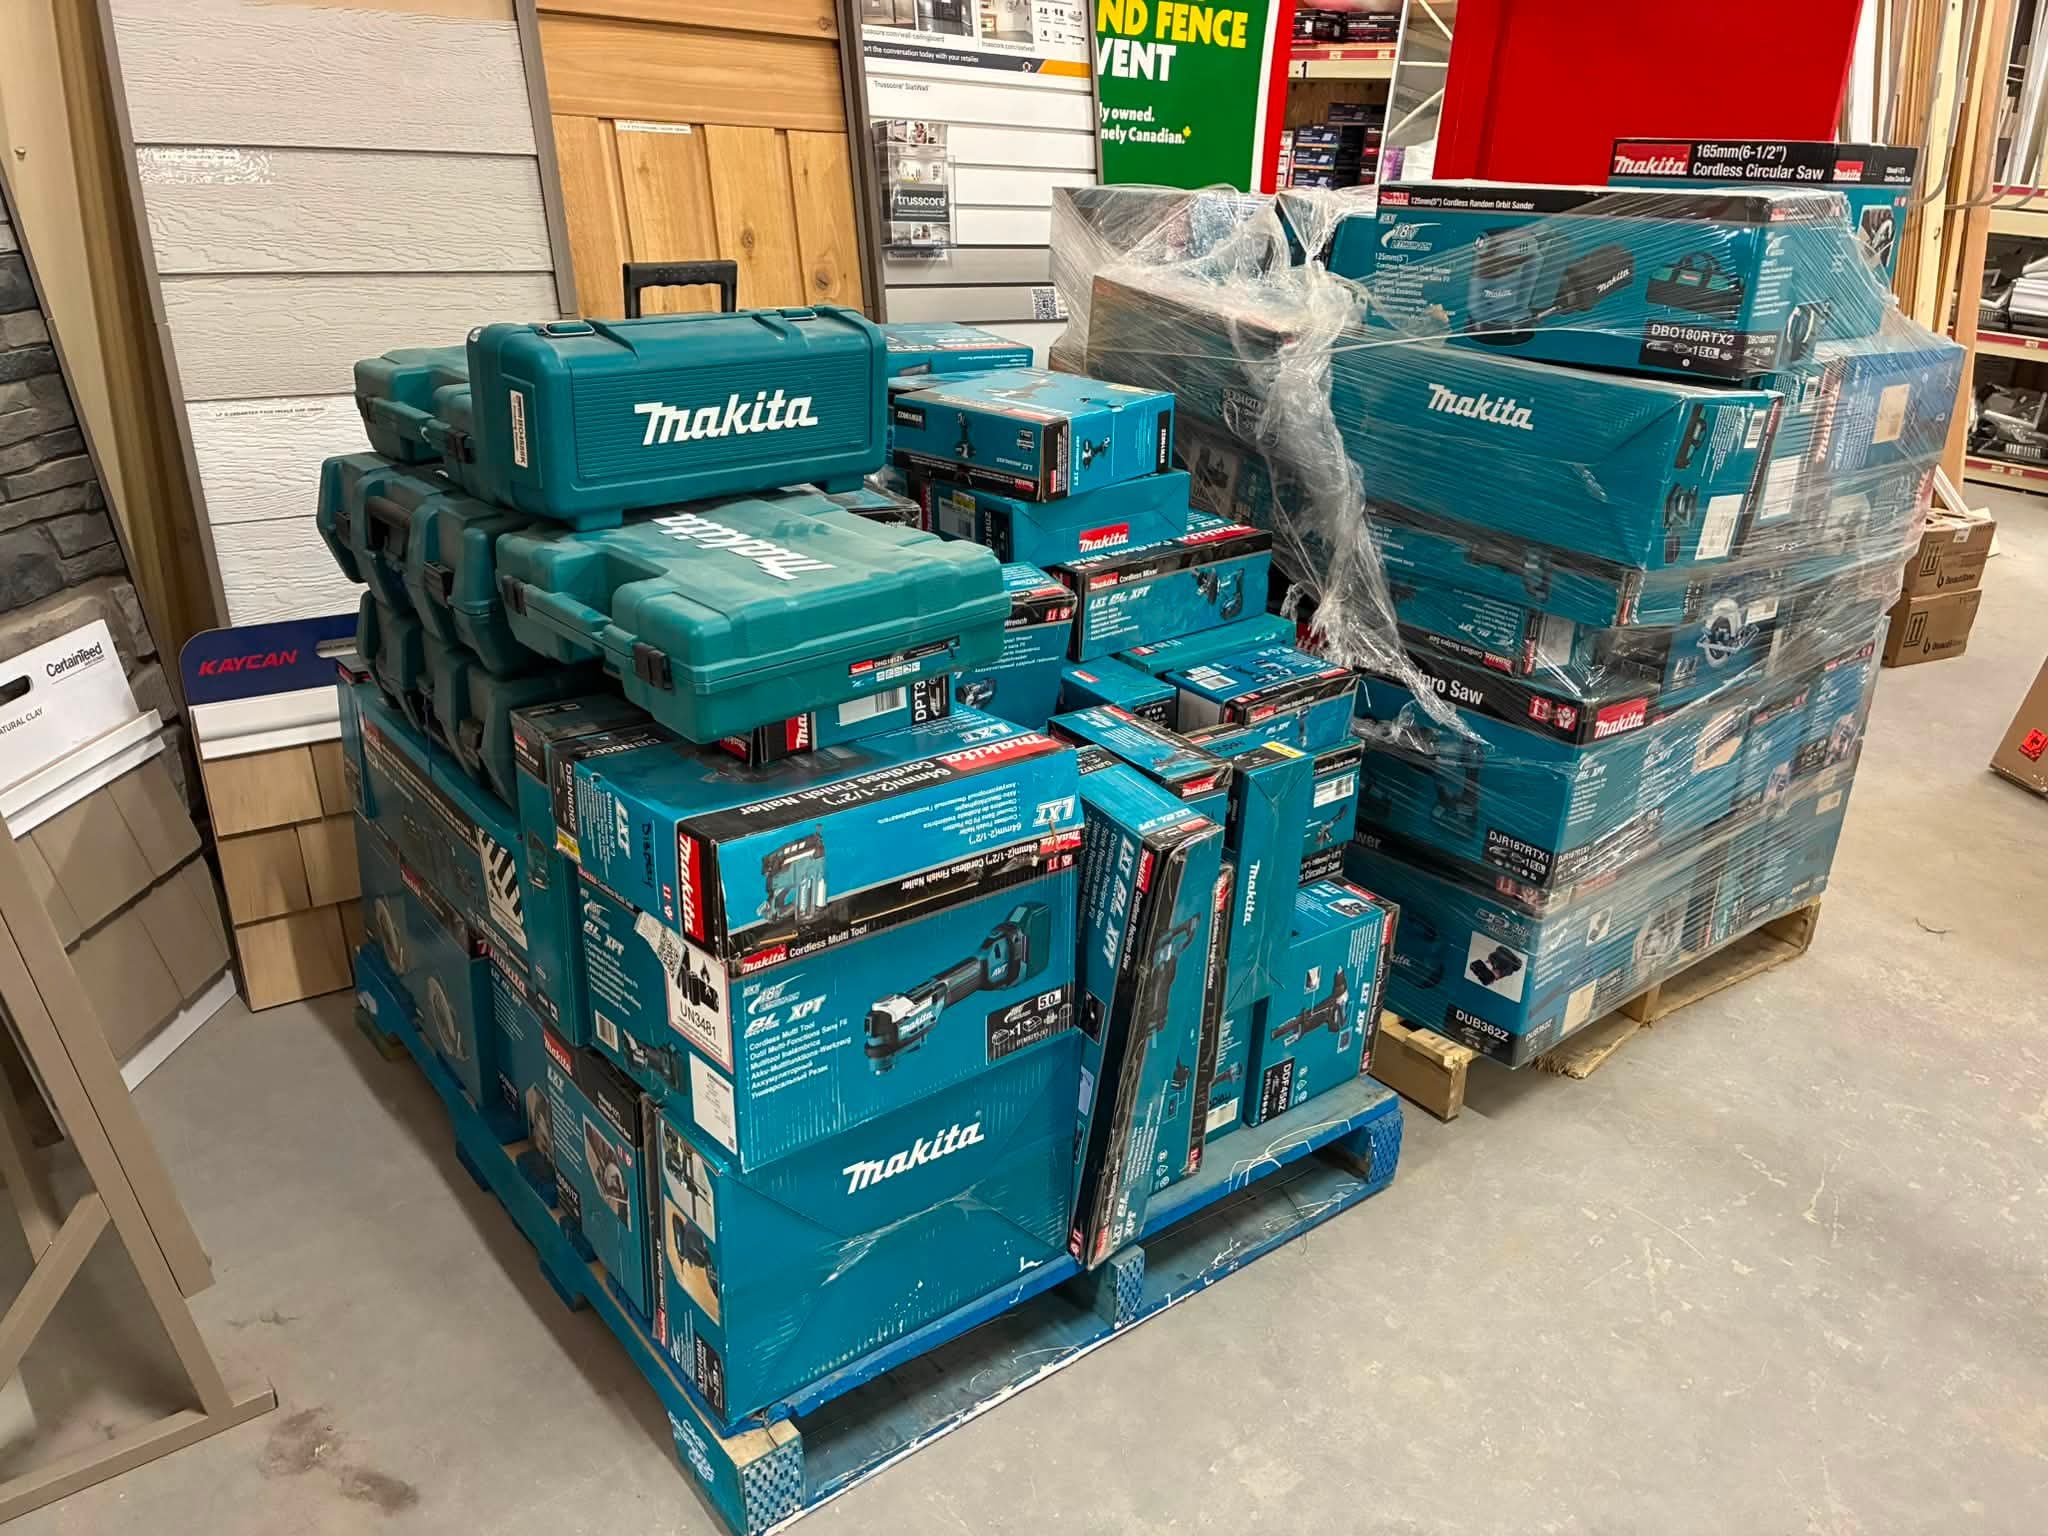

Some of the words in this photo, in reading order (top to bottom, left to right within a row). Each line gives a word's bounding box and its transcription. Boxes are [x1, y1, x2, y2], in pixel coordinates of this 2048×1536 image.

[1155, 1, 1248, 48] FENCE
[873, 46, 883, 54] the
[883, 47, 919, 57] conversation
[919, 51, 934, 60] today
[935, 52, 948, 61] with
[1095, 37, 1176, 81] VENT
[1111, 106, 1155, 122] owned.
[1128, 127, 1185, 144] Canadian.
[1697, 144, 1787, 161] 165mm(6-1/2")
[1692, 162, 1743, 177] Cordless
[1746, 164, 1794, 179] Circular
[1796, 166, 1824, 180] Saw
[897, 193, 946, 207] trusscore
[1443, 197, 1469, 207] Cordless
[1469, 199, 1495, 208] Random
[1496, 200, 1511, 209] Orbit
[1512, 200, 1535, 210] Sander
[1651, 324, 1735, 346] DBO180RTX2
[1119, 572, 1142, 583] Cordless
[1129, 585, 1151, 600] XPT
[46, 641, 103, 678] CertainTeed
[199, 650, 297, 676] KAYCAN
[1450, 679, 1483, 705] Saw
[0, 717, 25, 737] ATURAL
[25, 707, 43, 723] CLAY
[959, 720, 1012, 744] LXT
[861, 760, 936, 786] Cordless
[565, 763, 577, 832] DBN600Z
[800, 781, 859, 806] Finish
[823, 768, 951, 806] 64mm(2-1/2")
[740, 791, 801, 816] Nailer
[1032, 793, 1077, 827] LXT
[615, 796, 631, 860] LXT
[969, 822, 1022, 845] 64mm(2-1/2")
[985, 842, 1038, 866] 64mm(2-1/2")
[1105, 832, 1118, 873] Cordless
[1118, 833, 1135, 880] LXT
[1489, 831, 1550, 863] DJR187RTX1
[926, 867, 950, 883] Finish
[951, 857, 984, 875] Cordless
[901, 876, 925, 891] Nailer
[1131, 890, 1143, 924] Cordless
[604, 934, 625, 956] XPT
[789, 940, 826, 958] Cordless
[827, 931, 848, 945] Multi
[850, 923, 866, 937] Tool
[1103, 915, 1120, 969] XPT
[1125, 923, 1136, 953] Recipro
[1122, 952, 1131, 971] Saw
[679, 1002, 717, 1041] UN3481
[786, 994, 827, 1023] XPT
[749, 1035, 780, 1051] Cordless
[782, 1027, 799, 1039] Multi
[800, 1020, 815, 1032] Tool
[1455, 1009, 1511, 1042] DUB362Z
[750, 1048, 767, 1061] Outil
[768, 1030, 820, 1054] Multi-Fonctions
[821, 1023, 838, 1034] Sans
[751, 1053, 780, 1071] Multitool
